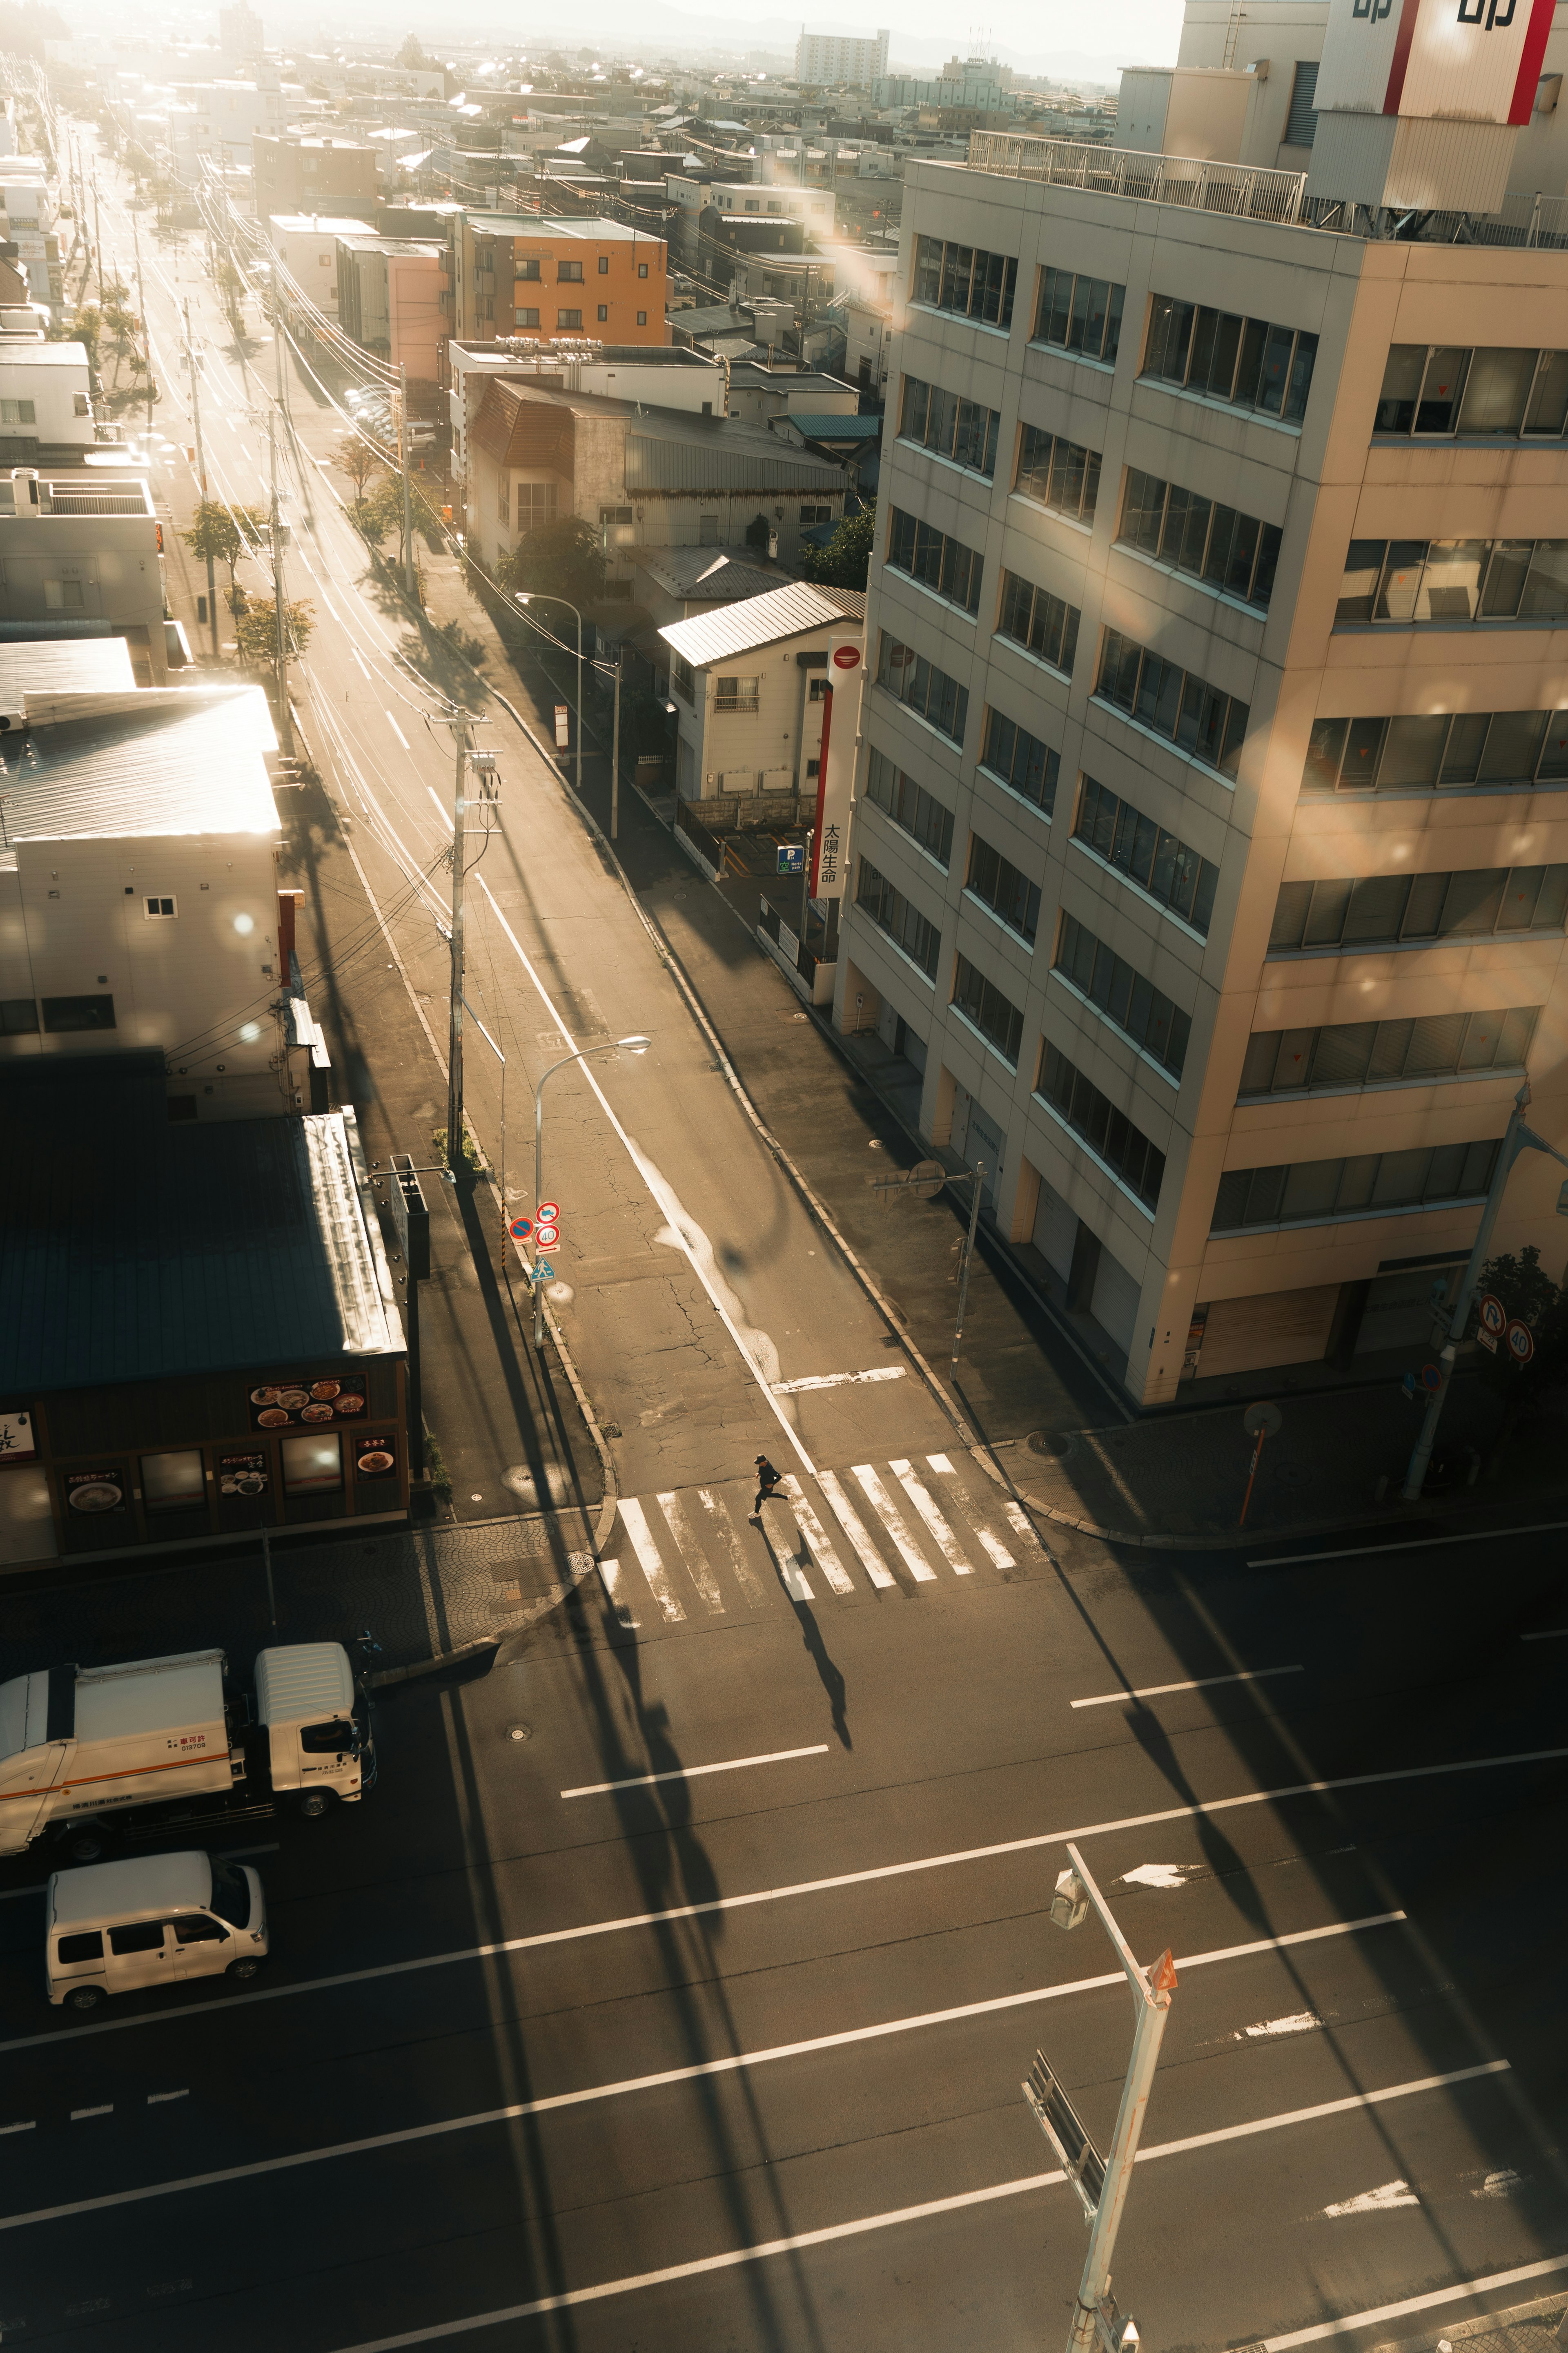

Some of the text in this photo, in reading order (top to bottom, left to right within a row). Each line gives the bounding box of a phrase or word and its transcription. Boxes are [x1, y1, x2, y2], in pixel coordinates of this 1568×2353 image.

[821, 823, 840, 883] 太陽生命
[541, 1230, 555, 1241] 40
[1511, 1330, 1527, 1353] 40
[363, 1439, 385, 1447] 春巻き
[247, 1460, 264, 1468] 定食
[182, 1742, 206, 1751] 013709
